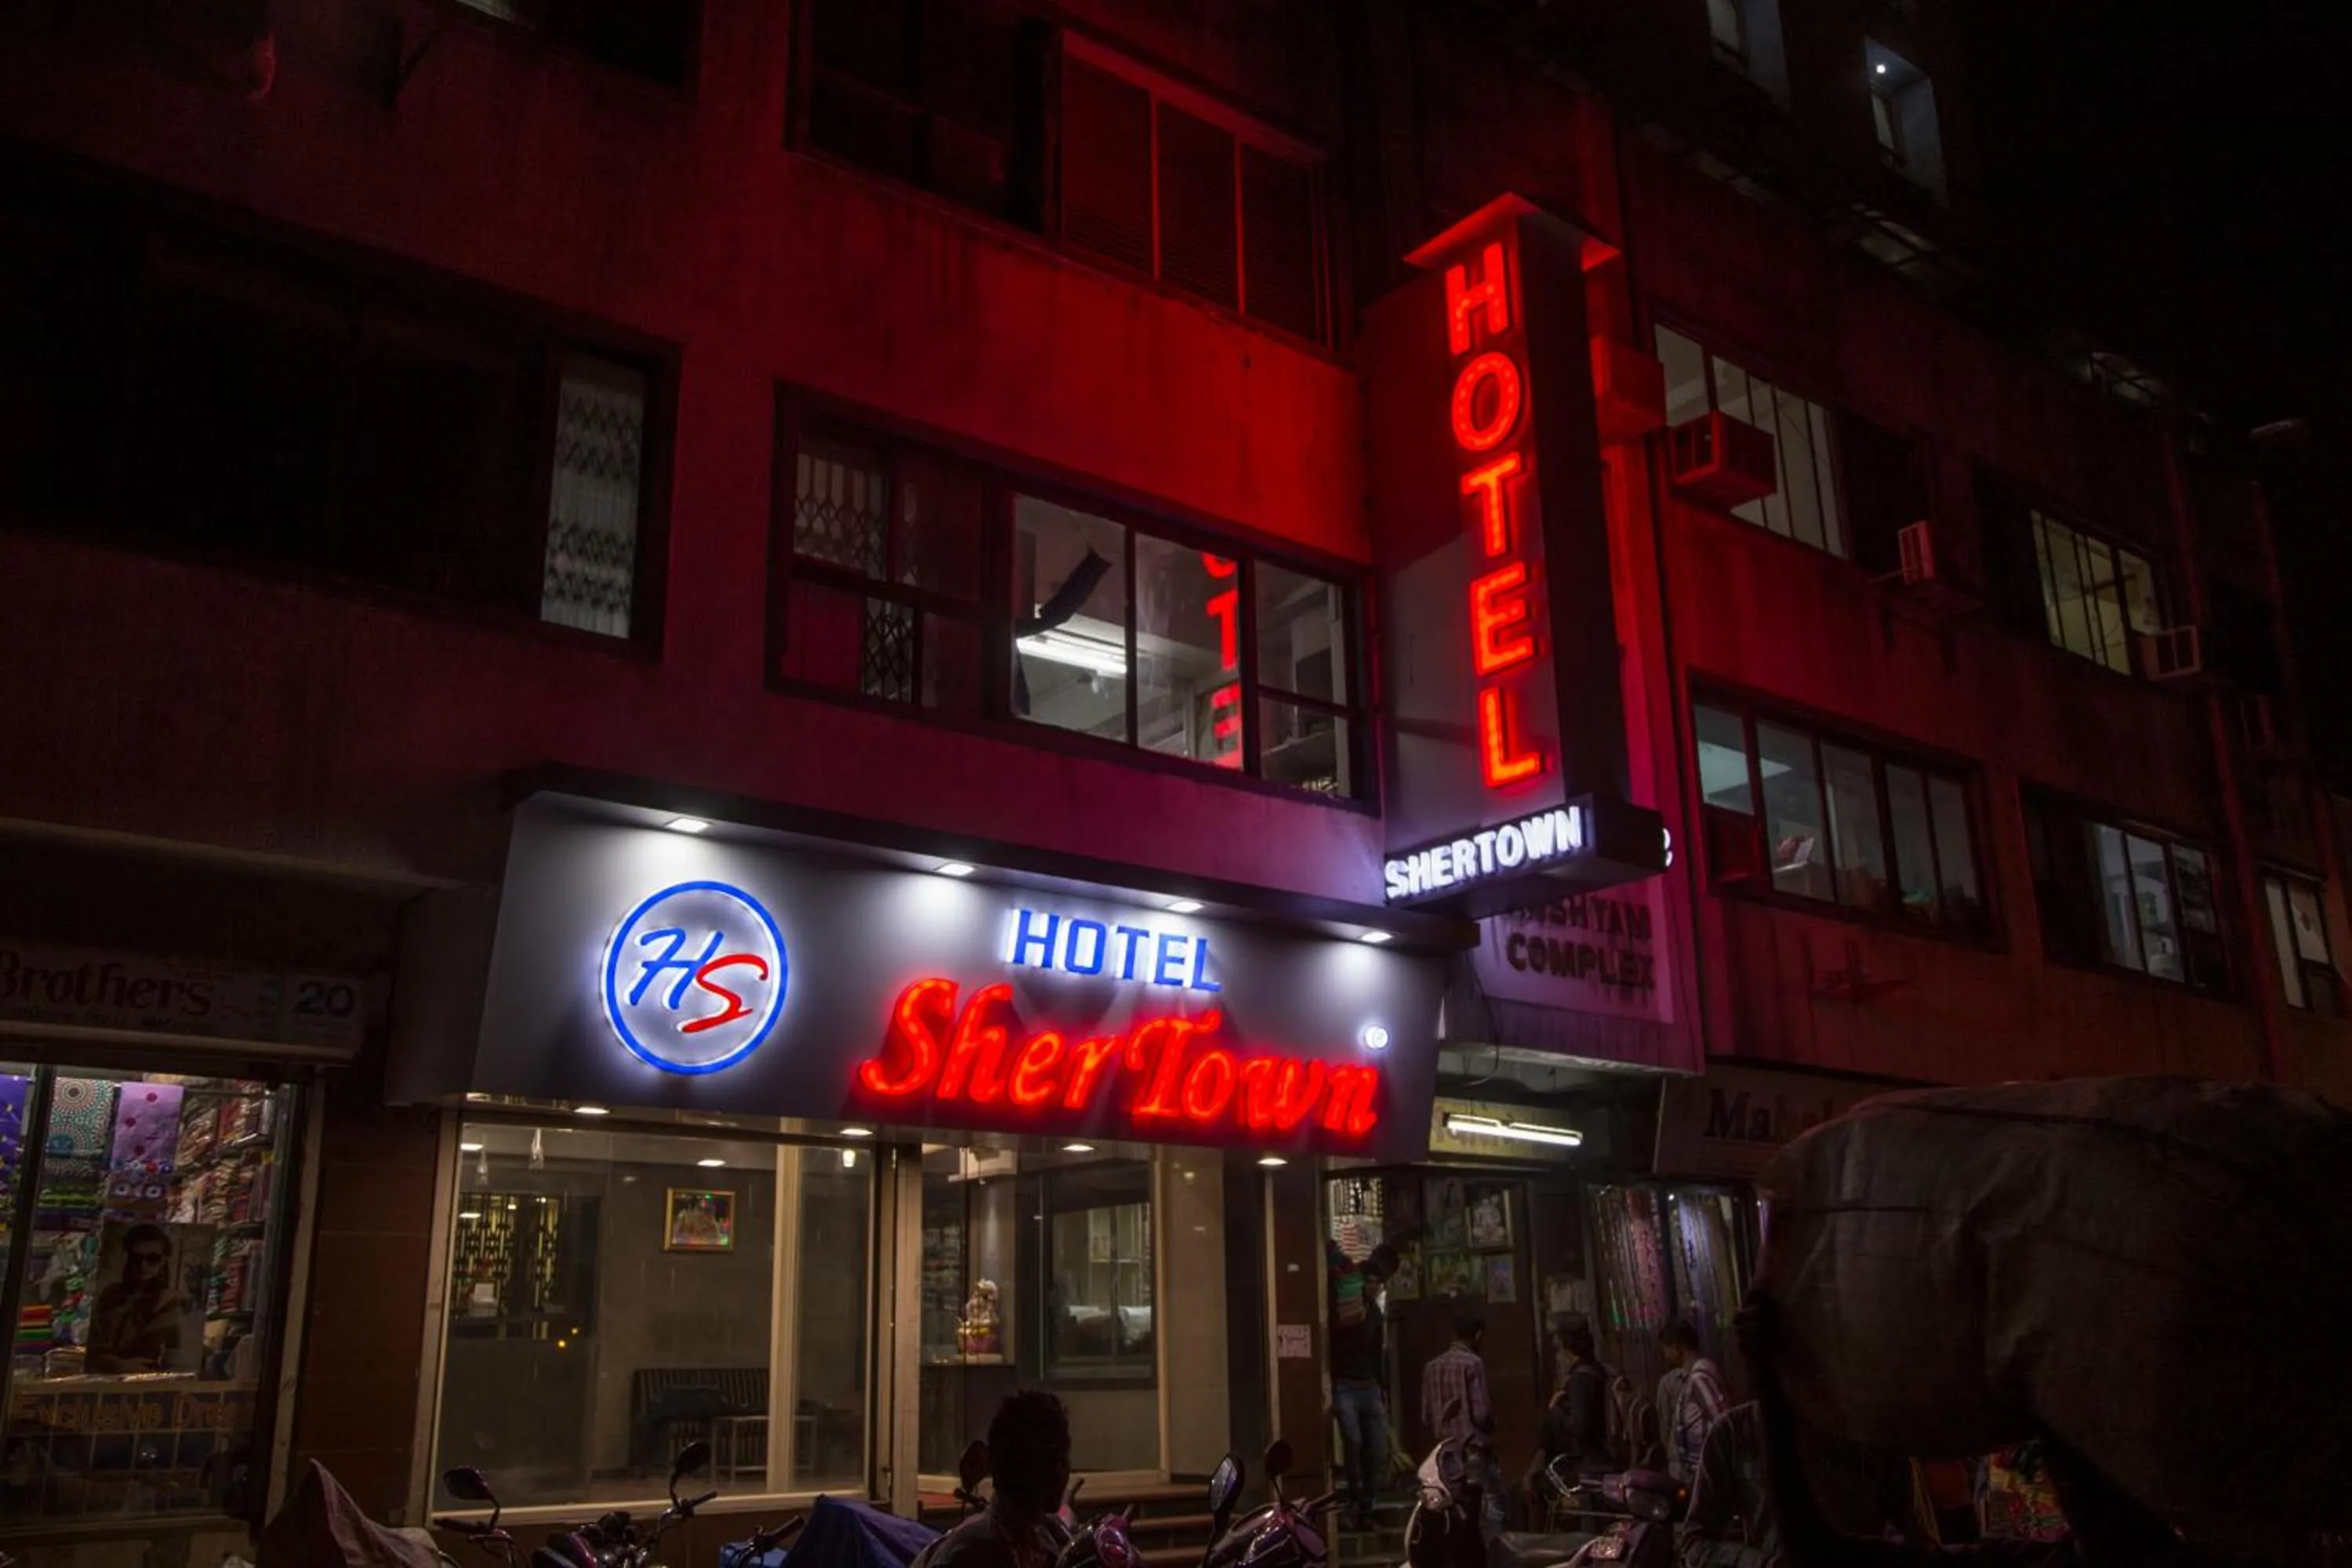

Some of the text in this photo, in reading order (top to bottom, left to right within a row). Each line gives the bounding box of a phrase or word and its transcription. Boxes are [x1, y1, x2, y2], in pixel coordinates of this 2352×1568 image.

[1446, 241, 1541, 789] HOTEL
[1385, 804, 1582, 900] SHERTOWN
[625, 927, 769, 1033] HS
[1008, 908, 1223, 993] HOTEL
[1506, 932, 1654, 990] COMPLEX
[294, 979, 355, 1017] 20
